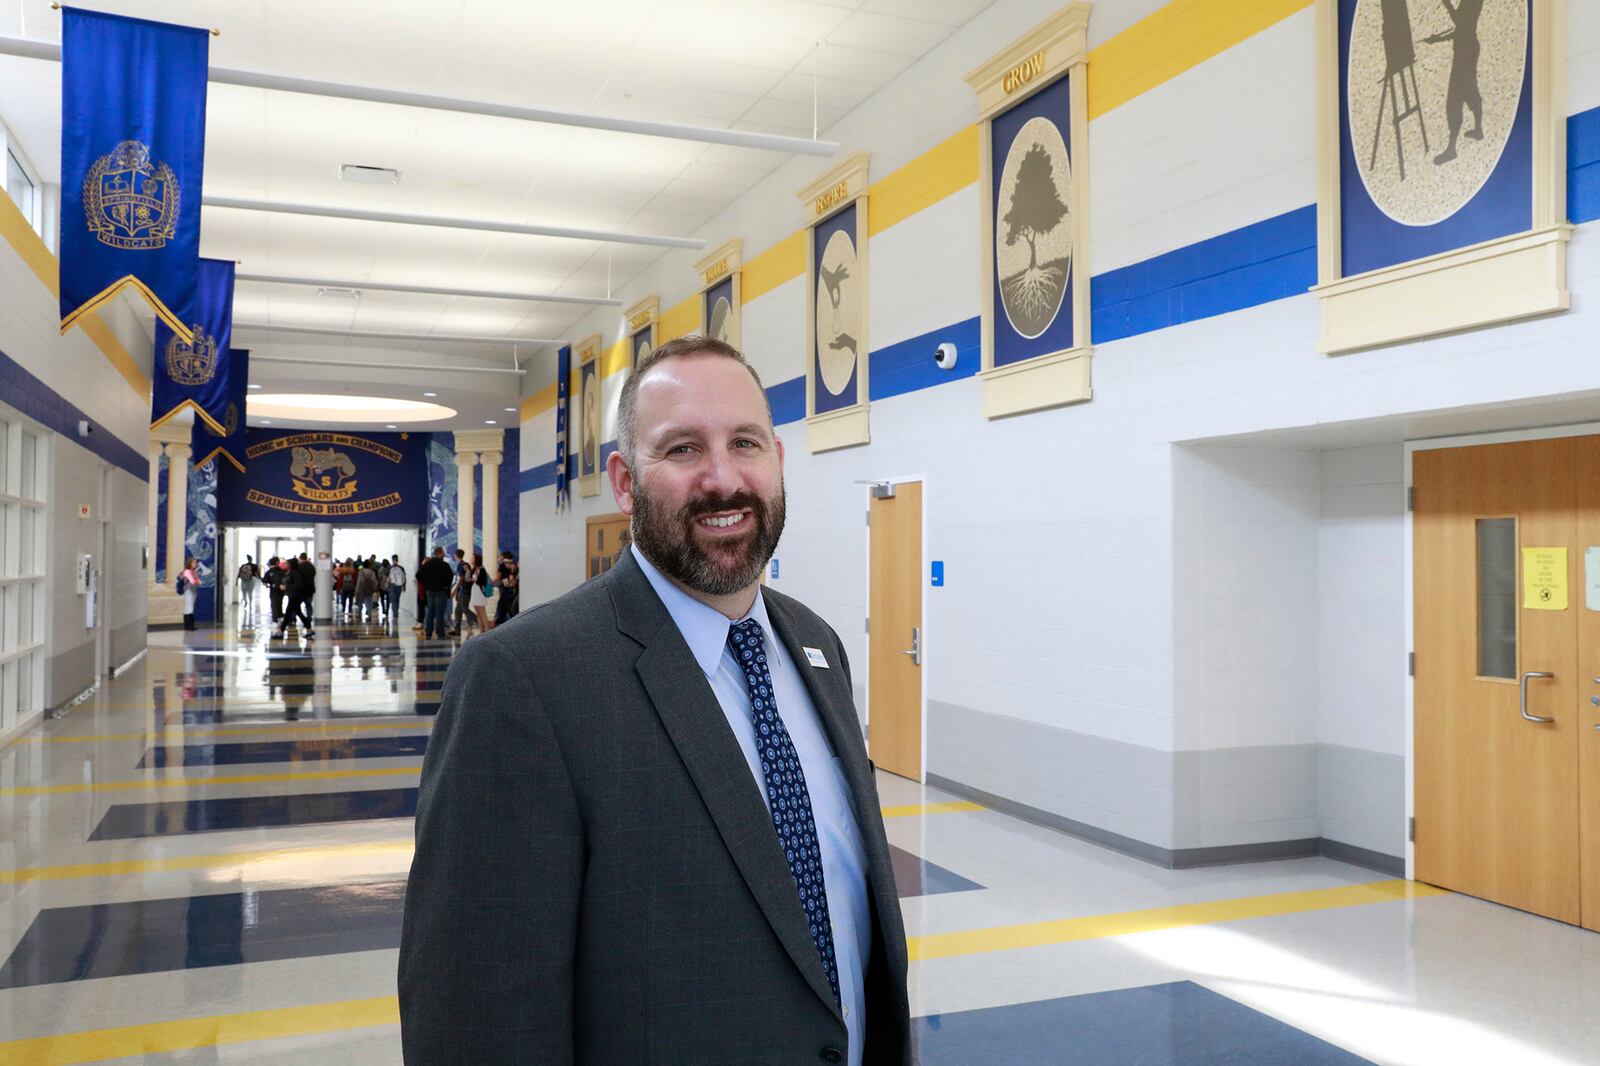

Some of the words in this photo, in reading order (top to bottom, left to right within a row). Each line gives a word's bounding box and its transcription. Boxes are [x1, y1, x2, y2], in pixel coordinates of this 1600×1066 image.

[1002, 51, 1044, 93] GROW
[103, 195, 163, 210] SPRINGFIELD
[101, 232, 162, 247] WILDCATS
[248, 441, 274, 457] HOME
[286, 434, 334, 446] SCHOLARS
[350, 438, 401, 463] CHAMPIONS
[321, 476, 331, 486] S
[302, 489, 350, 499] WILDCATS
[249, 490, 324, 513] SPRINGFIELD
[327, 503, 354, 514] HIGH
[357, 493, 400, 512] SCHOOL
